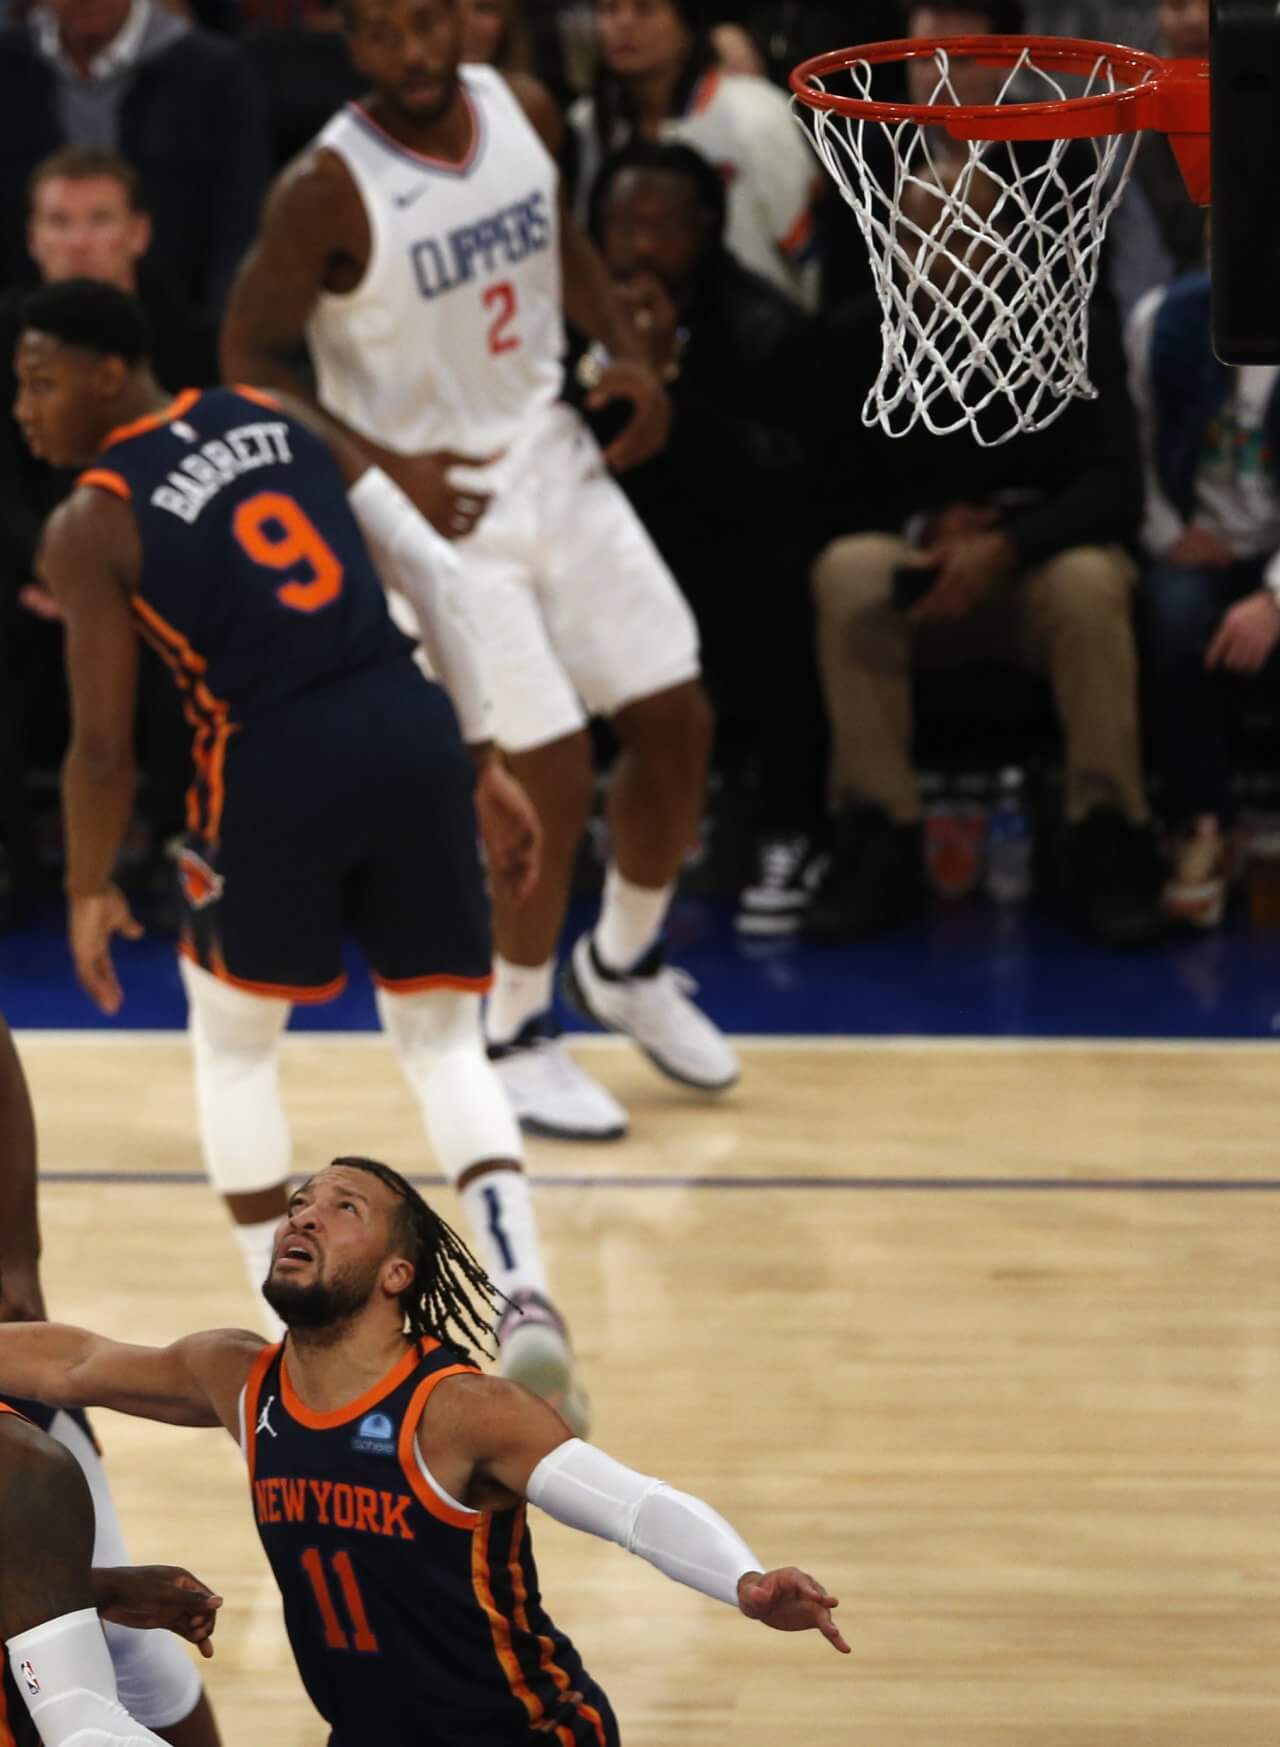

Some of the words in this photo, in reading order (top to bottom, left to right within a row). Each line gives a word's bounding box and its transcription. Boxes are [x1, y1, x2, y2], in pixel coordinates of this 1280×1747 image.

[410, 190, 548, 300] CLIPPERS
[481, 279, 523, 357] 2
[150, 421, 293, 524] BARRETT
[232, 490, 344, 614] 9
[309, 1479, 414, 1541] YORK
[300, 1547, 381, 1654] 11
